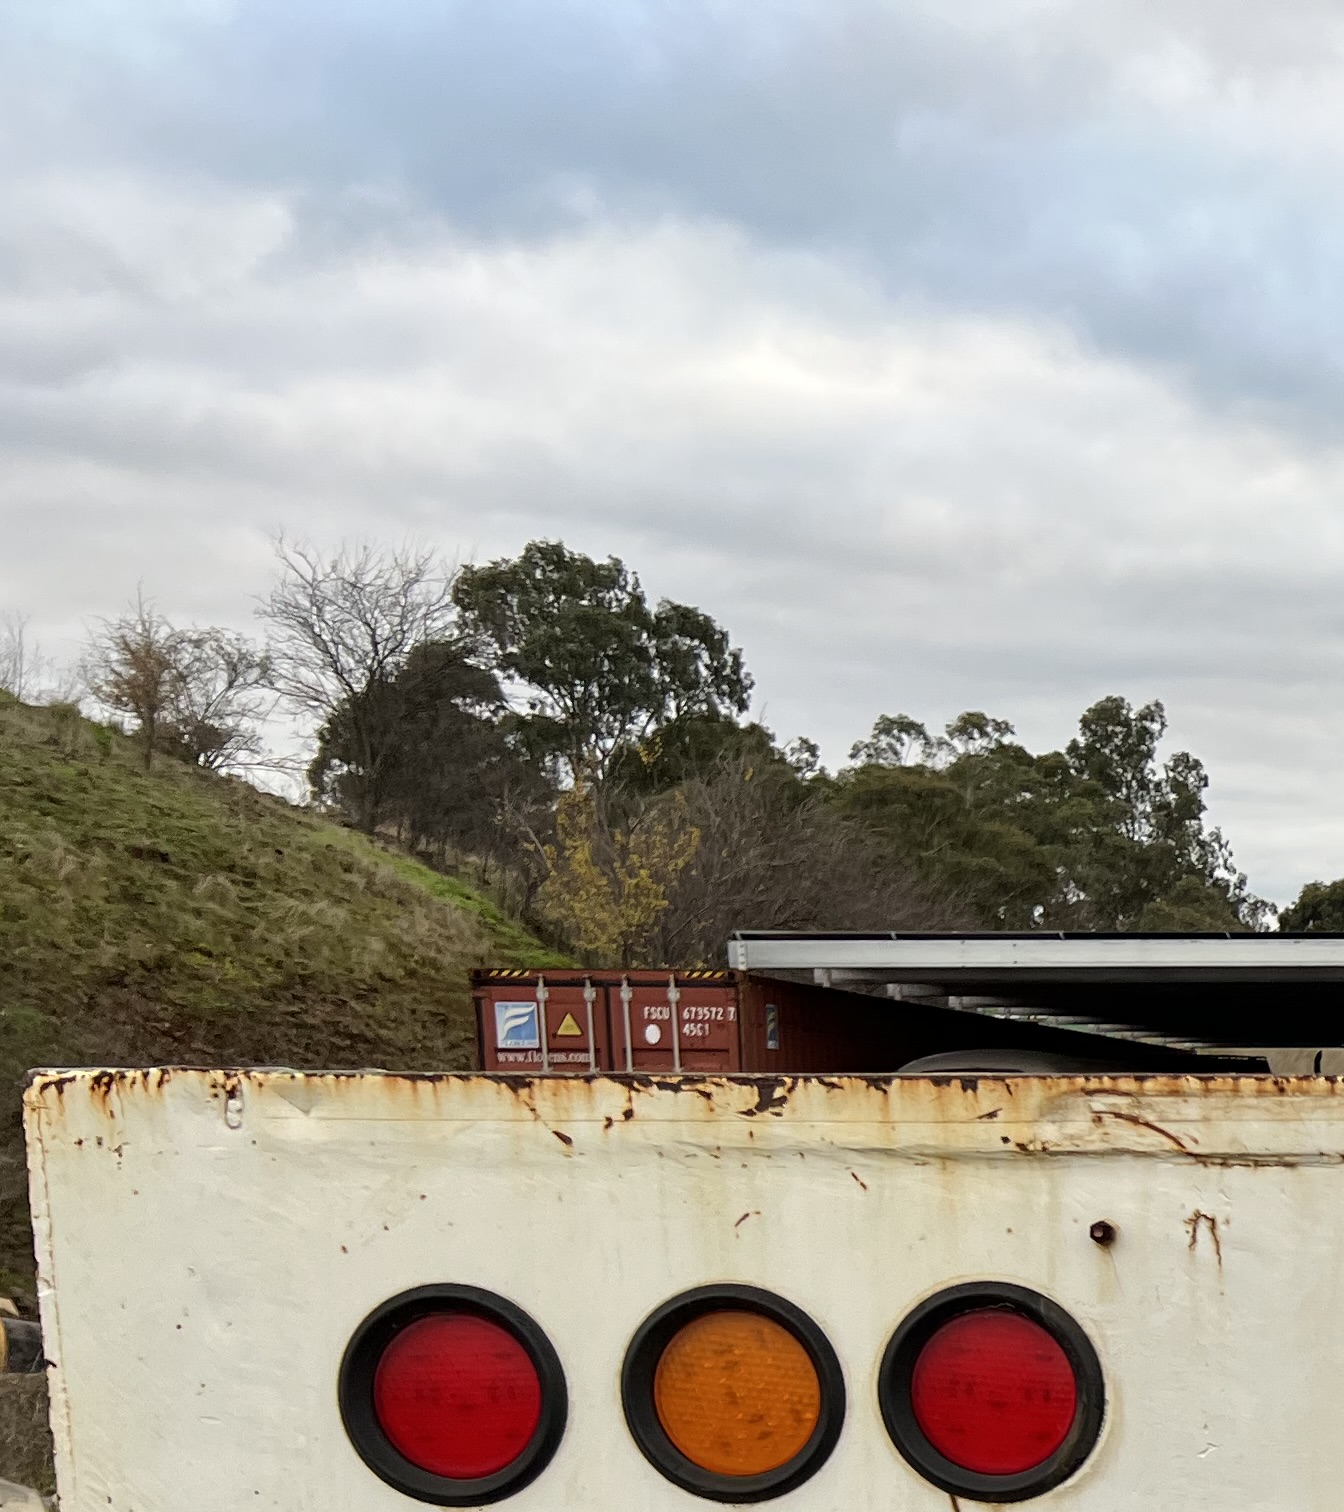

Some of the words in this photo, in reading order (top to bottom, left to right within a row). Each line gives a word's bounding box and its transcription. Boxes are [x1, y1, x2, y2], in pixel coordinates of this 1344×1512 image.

[644, 1006, 670, 1020] FSCU
[682, 1006, 724, 1021] 673572
[497, 1050, 591, 1064] www.floens.com
